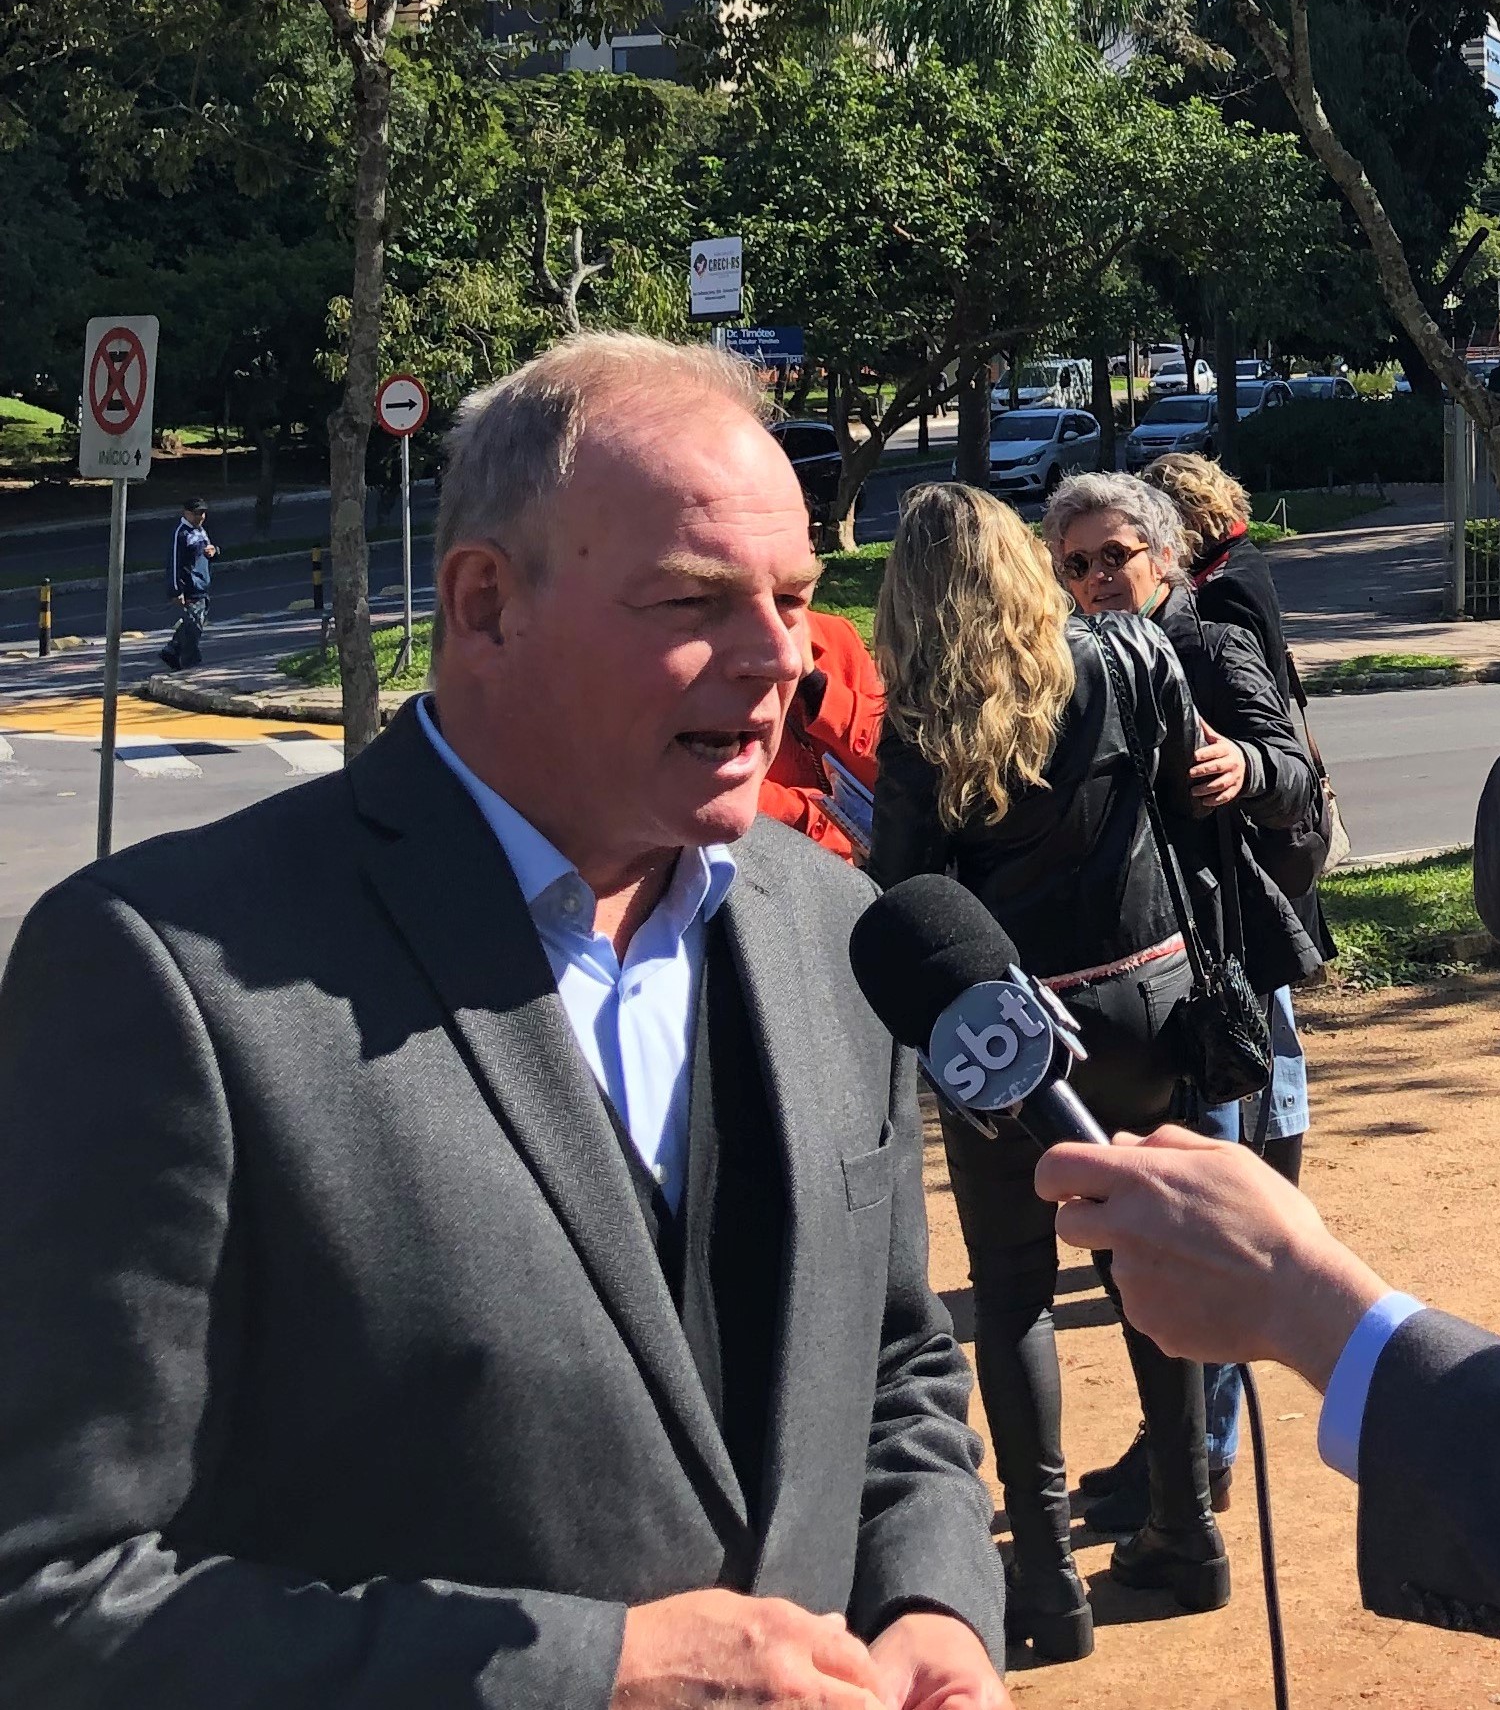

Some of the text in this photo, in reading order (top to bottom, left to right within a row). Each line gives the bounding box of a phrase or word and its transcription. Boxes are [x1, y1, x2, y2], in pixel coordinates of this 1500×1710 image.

[708, 256, 740, 271] CRECI-RS
[740, 328, 776, 338] Timóteo
[943, 989, 1046, 1101] sbt
